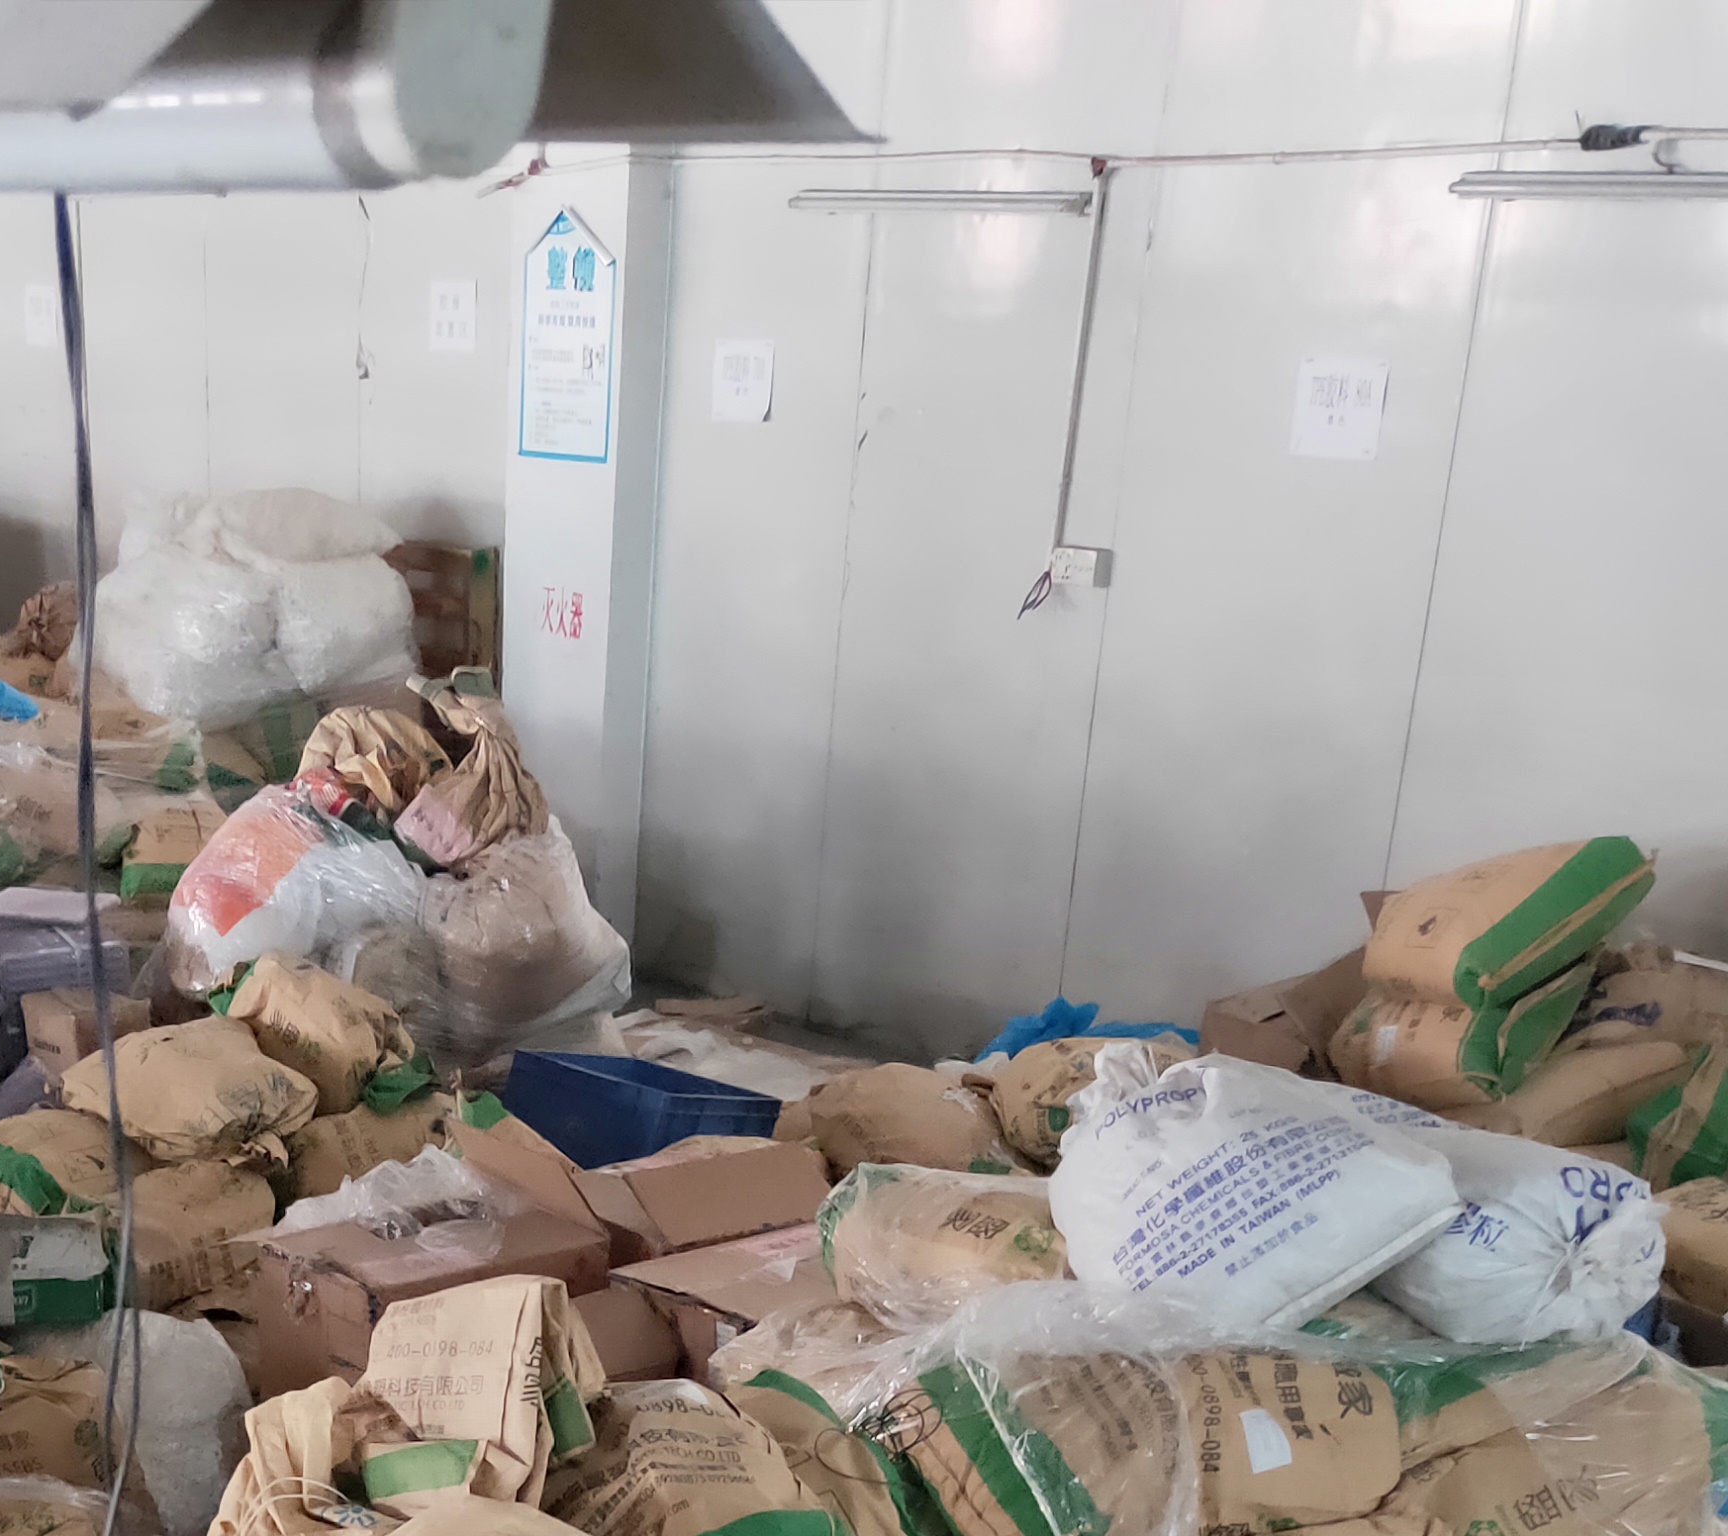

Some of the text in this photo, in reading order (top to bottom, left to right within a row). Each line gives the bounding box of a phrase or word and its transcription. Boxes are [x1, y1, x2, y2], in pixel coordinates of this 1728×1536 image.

[541, 585, 584, 640] 灭火器
[1116, 1136, 1314, 1277] FORMOSA CHEMICALS & FIBRE
[1133, 1189, 1165, 1218] NET
[1165, 1138, 1236, 1191] WEIGHT:
[1176, 1166, 1342, 1279] MADE IN TAIWAN (MLPP)
